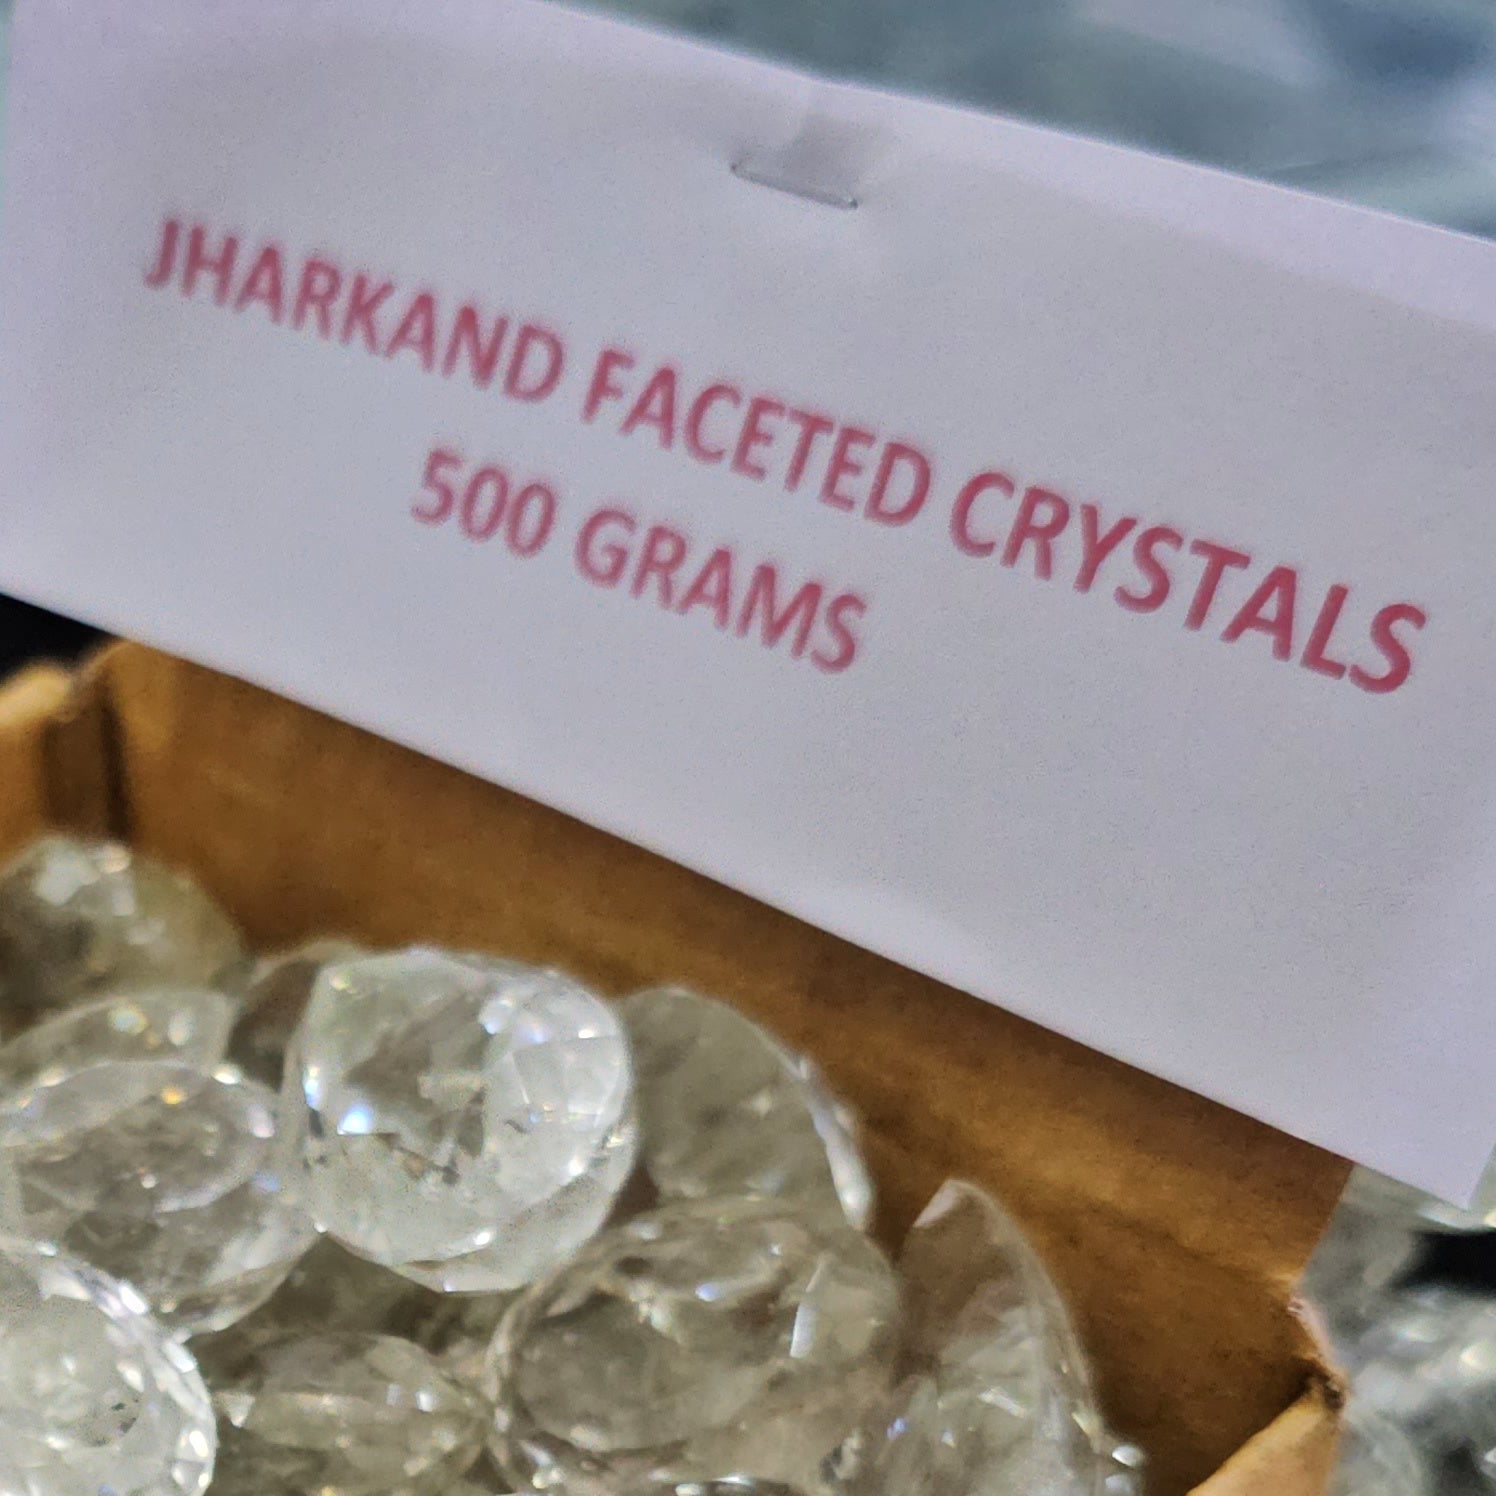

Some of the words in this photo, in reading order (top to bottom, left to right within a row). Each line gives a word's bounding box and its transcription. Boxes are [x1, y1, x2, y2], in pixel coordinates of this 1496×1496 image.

[145, 217, 566, 403] JHARKAND
[582, 344, 931, 526] FACETED
[948, 468, 1429, 695] CRYSTALS
[414, 447, 555, 556] 500
[574, 504, 870, 674] GRAMS
